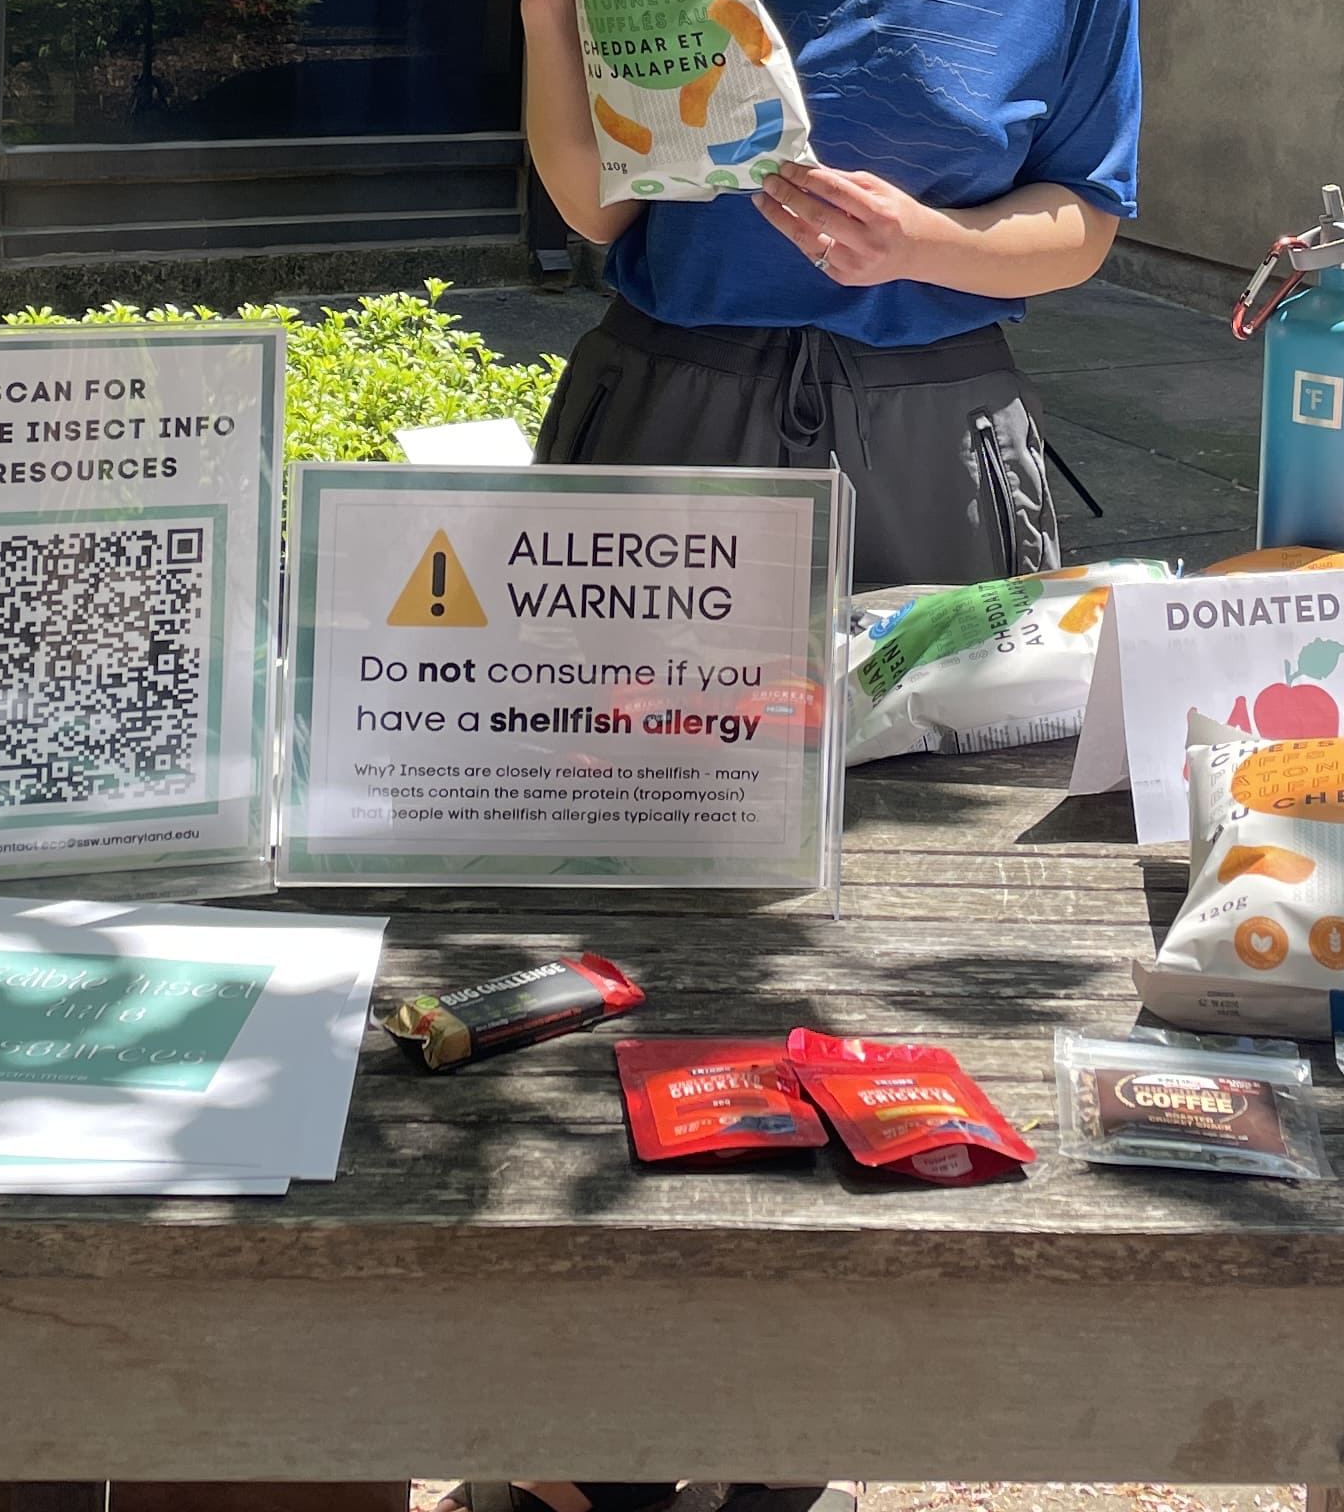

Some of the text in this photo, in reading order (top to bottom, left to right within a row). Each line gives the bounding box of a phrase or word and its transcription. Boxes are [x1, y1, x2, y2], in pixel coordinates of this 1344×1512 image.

[582, 10, 667, 34] UFFLÉS
[583, 32, 704, 56] CHEDDAR ET
[588, 52, 726, 79] AU JALAPEÑO
[84, 378, 147, 401] FOR
[25, 418, 146, 443] INSECT
[158, 415, 236, 438] INFO
[507, 531, 738, 569] ALLERGEN
[507, 583, 734, 621] WARNING
[1166, 593, 1341, 631] DONATED
[360, 655, 762, 692] Do not consume if you
[356, 705, 762, 744] have a shellfish allergy
[354, 763, 396, 779] Why?
[399, 764, 461, 778] Insects
[464, 766, 492, 778] are
[495, 765, 552, 780] closely
[555, 766, 613, 779] related
[617, 768, 633, 779] to
[636, 766, 700, 780] shellfish
[715, 768, 760, 783] many
[367, 784, 746, 803] insects contain the same protein (tropomyosin)
[351, 806, 383, 820] that
[387, 807, 444, 822] people
[447, 807, 479, 820] with
[483, 807, 548, 821] shellfish
[551, 809, 620, 824] allergies
[624, 809, 690, 824] typically
[694, 810, 737, 823] react
[1199, 894, 1249, 923] 120g
[440, 988, 480, 1007] BUG
[477, 961, 567, 994] CHALLENGE
[38, 1072, 89, 1082] more
[1135, 1091, 1234, 1115] COFFEE
